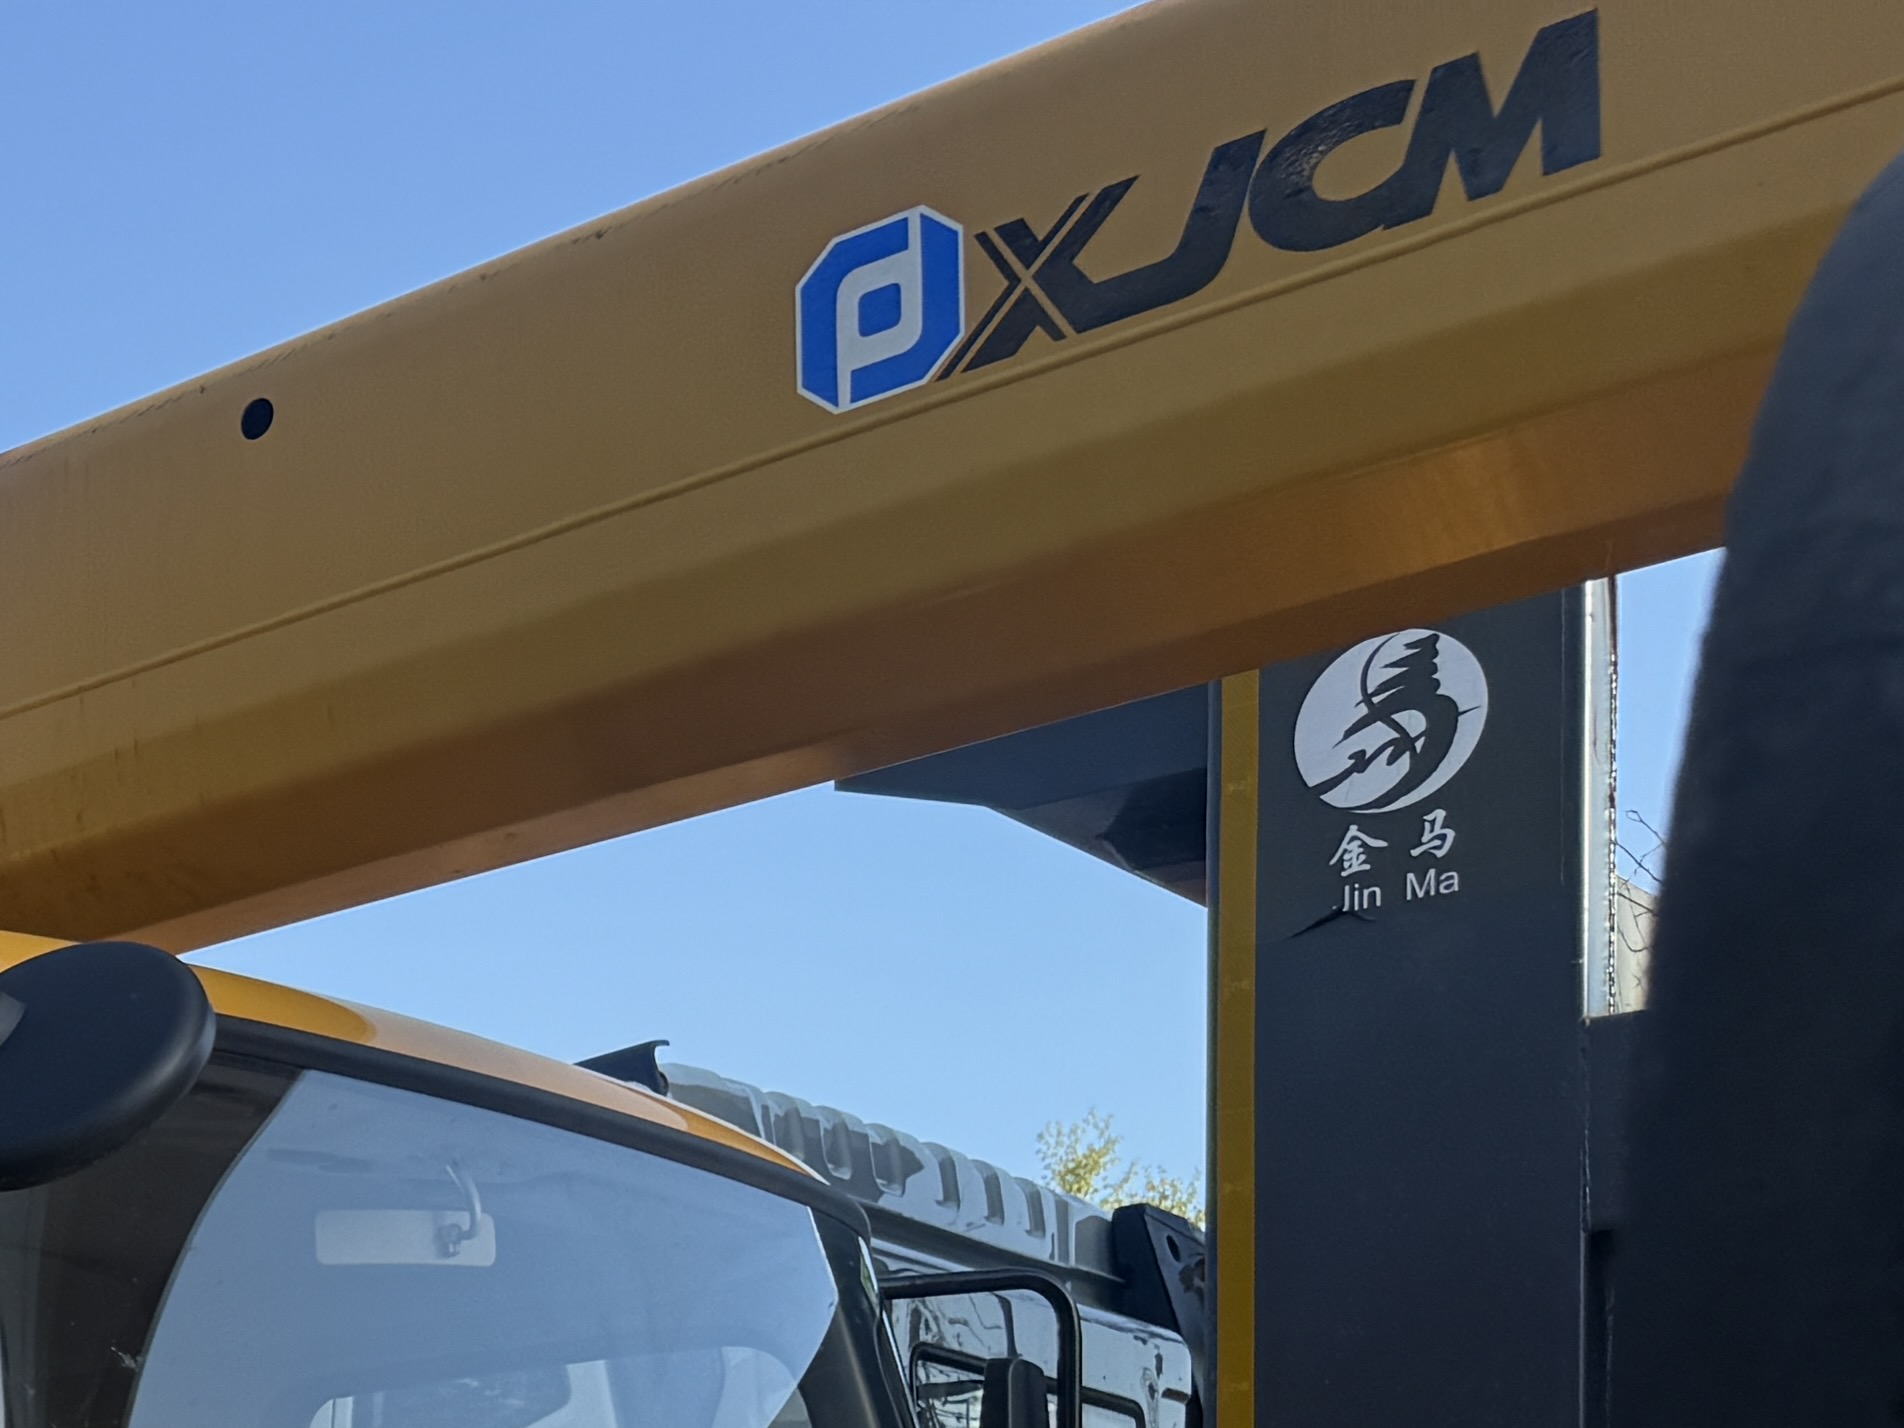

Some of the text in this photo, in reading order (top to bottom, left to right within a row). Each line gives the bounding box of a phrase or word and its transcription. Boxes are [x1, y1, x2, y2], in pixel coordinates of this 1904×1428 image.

[1329, 808, 1456, 877] 金马
[1342, 868, 1459, 912] Jin Ma
